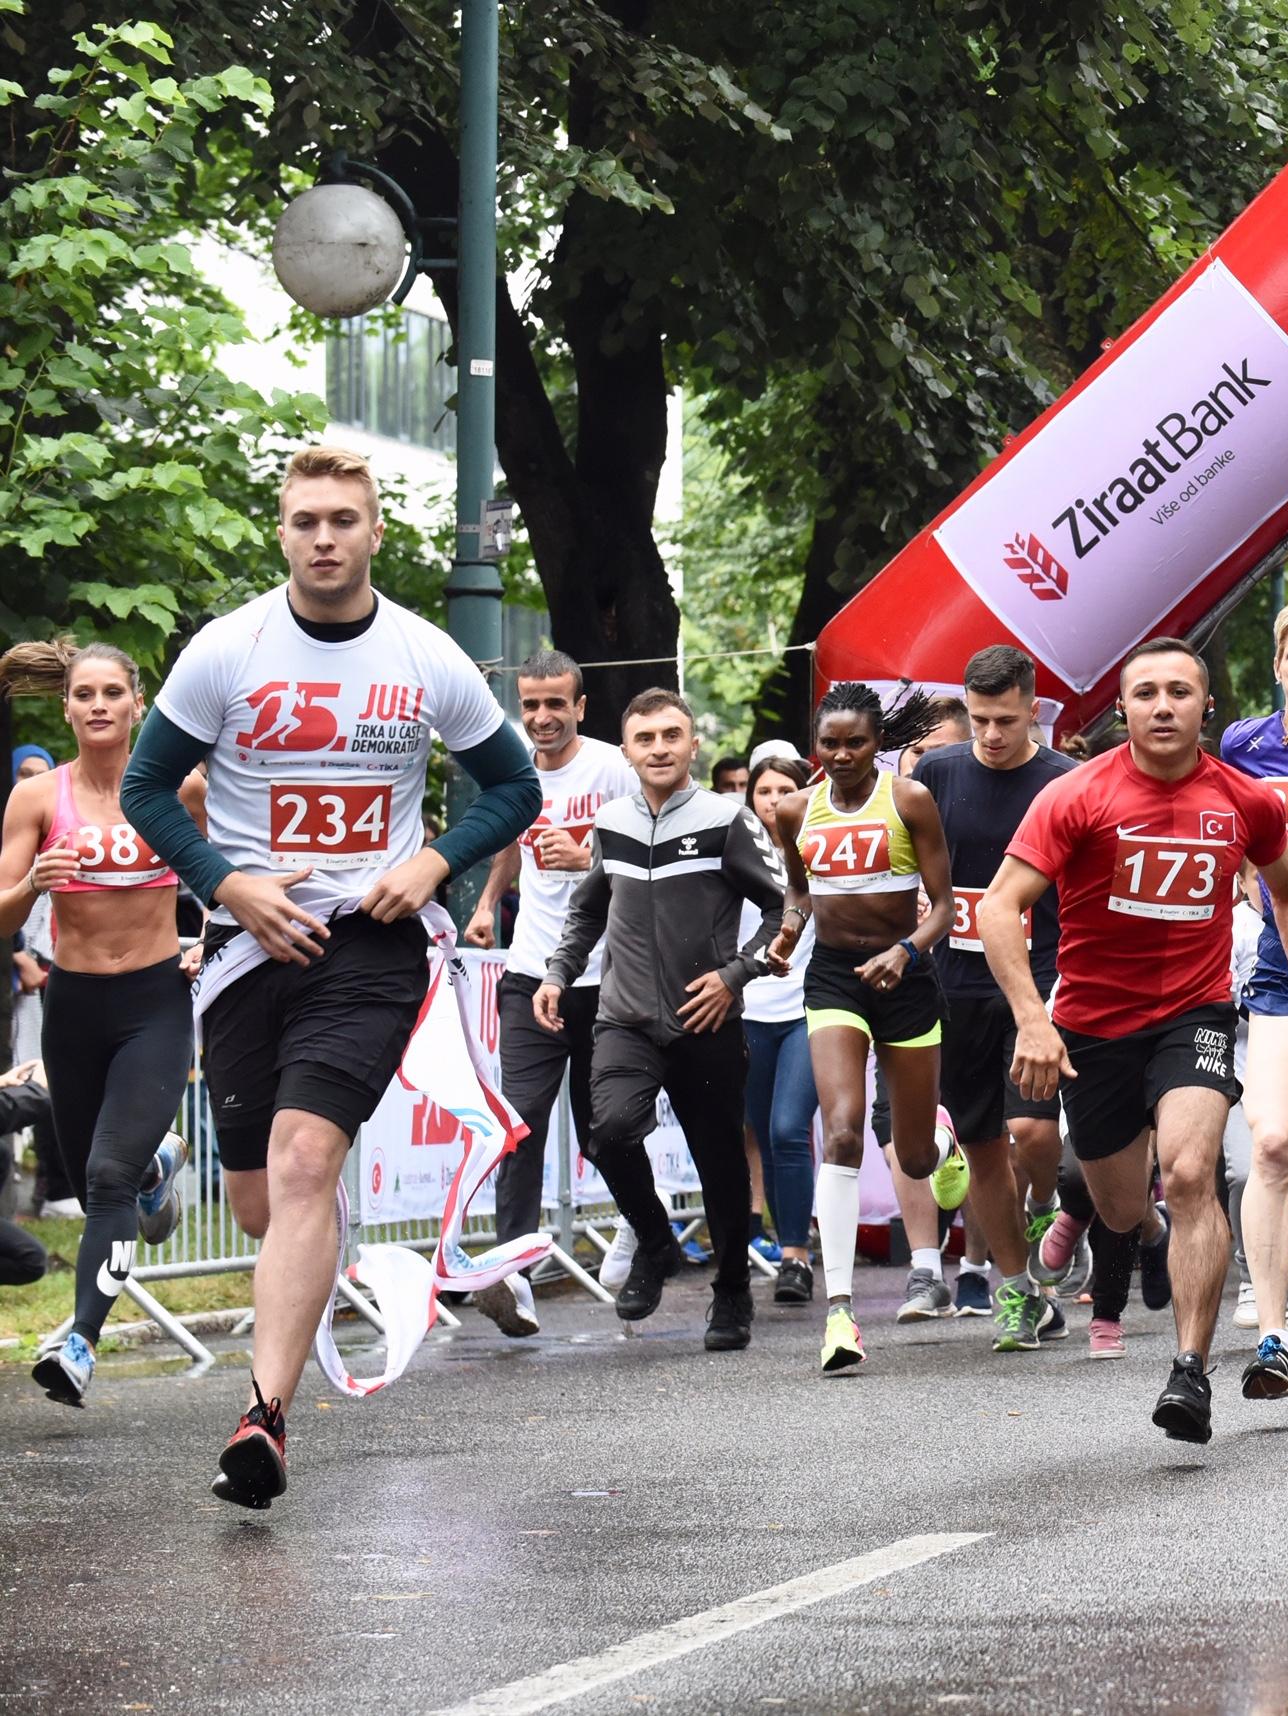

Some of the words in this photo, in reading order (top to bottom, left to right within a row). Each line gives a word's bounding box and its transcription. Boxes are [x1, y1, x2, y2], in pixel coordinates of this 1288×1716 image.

[1051, 358, 1272, 560] ZiraatBank
[1149, 502, 1182, 526] Više
[1179, 481, 1199, 503] od
[1196, 448, 1236, 486] banke
[359, 684, 424, 722] JULI
[355, 724, 385, 739] TRKA
[388, 725, 397, 738] U
[399, 723, 421, 739] ČAST
[277, 793, 385, 846] 234
[79, 823, 160, 866] 38
[807, 829, 884, 872] 247
[1124, 849, 1216, 899] 173
[1195, 1055, 1227, 1078] NIKE
